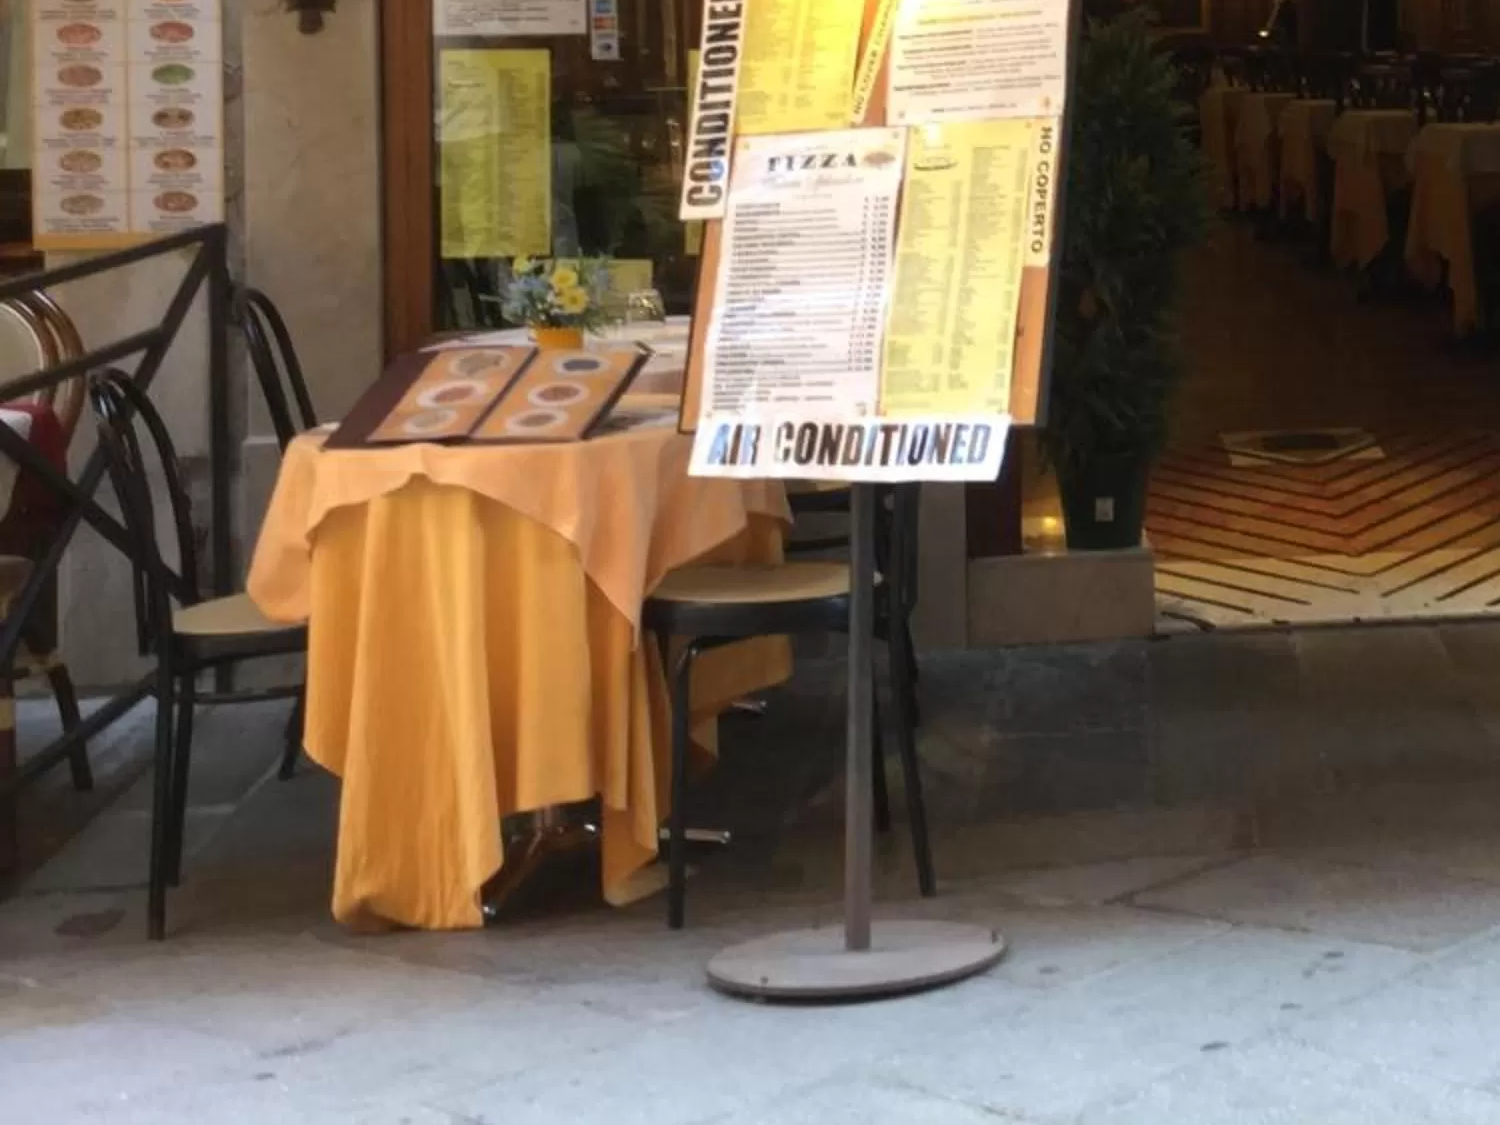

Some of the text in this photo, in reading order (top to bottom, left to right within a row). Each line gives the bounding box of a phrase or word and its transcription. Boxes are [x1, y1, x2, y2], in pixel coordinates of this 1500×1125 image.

[1031, 126, 1053, 253] NO COPERTO
[707, 421, 992, 466] AIR CONDITIONED
